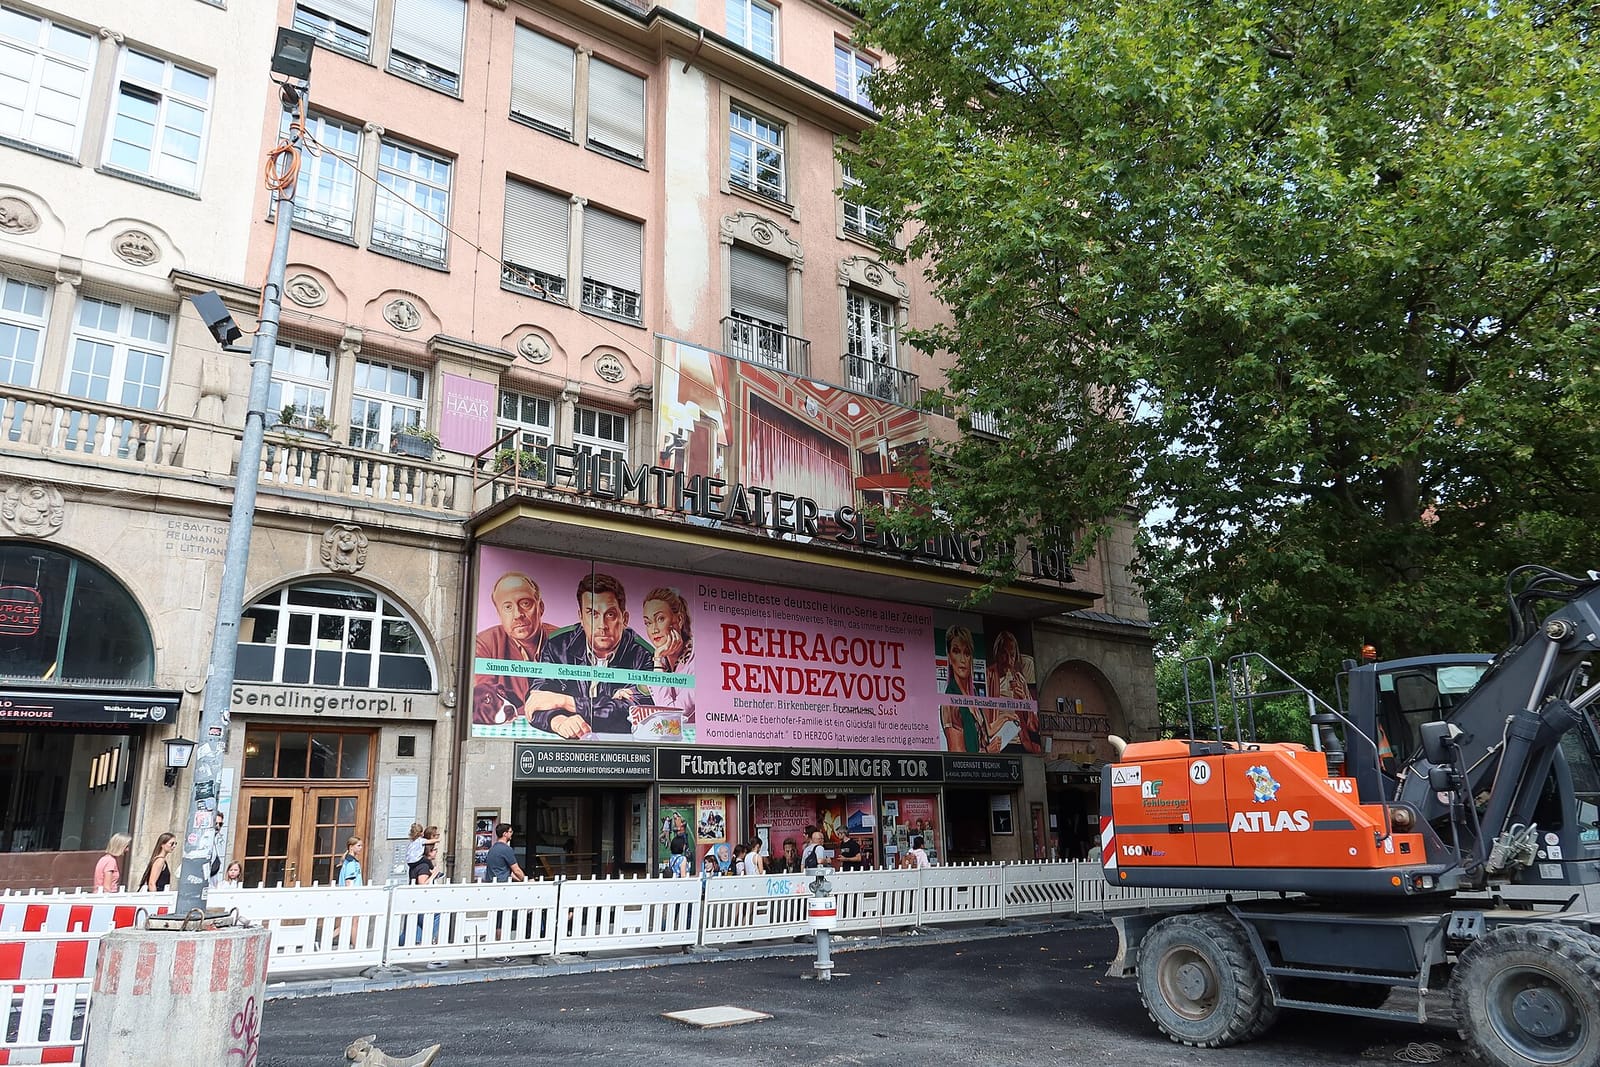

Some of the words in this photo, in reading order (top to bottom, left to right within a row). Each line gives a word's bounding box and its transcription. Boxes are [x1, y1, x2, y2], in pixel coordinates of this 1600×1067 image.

[446, 395, 489, 417] HAAR
[545, 443, 820, 537] FILMTHEATER
[166, 530, 220, 545] HEILMANN
[698, 584, 718, 598] Die
[720, 587, 781, 606] beliebteste
[783, 595, 829, 613] deutsche
[880, 609, 900, 622] aller
[901, 611, 932, 626] Zeiten!
[703, 601, 717, 612] Ein
[718, 603, 772, 618] eingespieltes
[772, 609, 824, 625] liebenswertes
[848, 620, 860, 629] das
[719, 622, 905, 670] REHRAGOUT
[485, 662, 510, 673] Simon
[511, 663, 543, 675] Schwarz
[557, 667, 591, 678] Sebastian
[592, 669, 615, 680] Bezzel
[627, 672, 642, 682] Lisa
[642, 673, 661, 683] Maria
[661, 675, 688, 685] Potthoff
[720, 661, 906, 703] RENDEZVOUS
[232, 687, 397, 715] Sendlingertorpl.
[402, 697, 413, 713] 11
[877, 703, 898, 716] Susi
[974, 698, 997, 708] Bestseller
[705, 712, 742, 723] CINEMA:
[759, 714, 823, 726] Eberhofer-Familie
[824, 718, 833, 727] ist
[833, 719, 845, 728] ein
[845, 719, 877, 729] Glücksfall
[877, 721, 888, 730] für
[888, 722, 899, 731] die
[899, 722, 929, 731] deutsche
[1039, 713, 1112, 734] ENNEDY'S
[792, 729, 803, 740] ED
[804, 730, 834, 741] HERZOG
[834, 733, 845, 742] hat
[846, 734, 869, 743] wieder
[870, 735, 886, 744] alles
[886, 736, 907, 746] richtig
[537, 751, 554, 761] DAS
[555, 752, 599, 762] BESONDERE
[600, 752, 651, 763] KINOERLEBNIS
[680, 754, 782, 776] Filmtheater
[790, 756, 892, 777] SENDLINGER
[897, 759, 929, 777] TOR
[545, 766, 586, 774] EINZIGARTIGEN
[586, 766, 625, 774] HISTORISCHEN
[625, 767, 651, 775] AMBIENTE
[1193, 764, 1207, 780] 20
[1229, 809, 1311, 833] ATLAS
